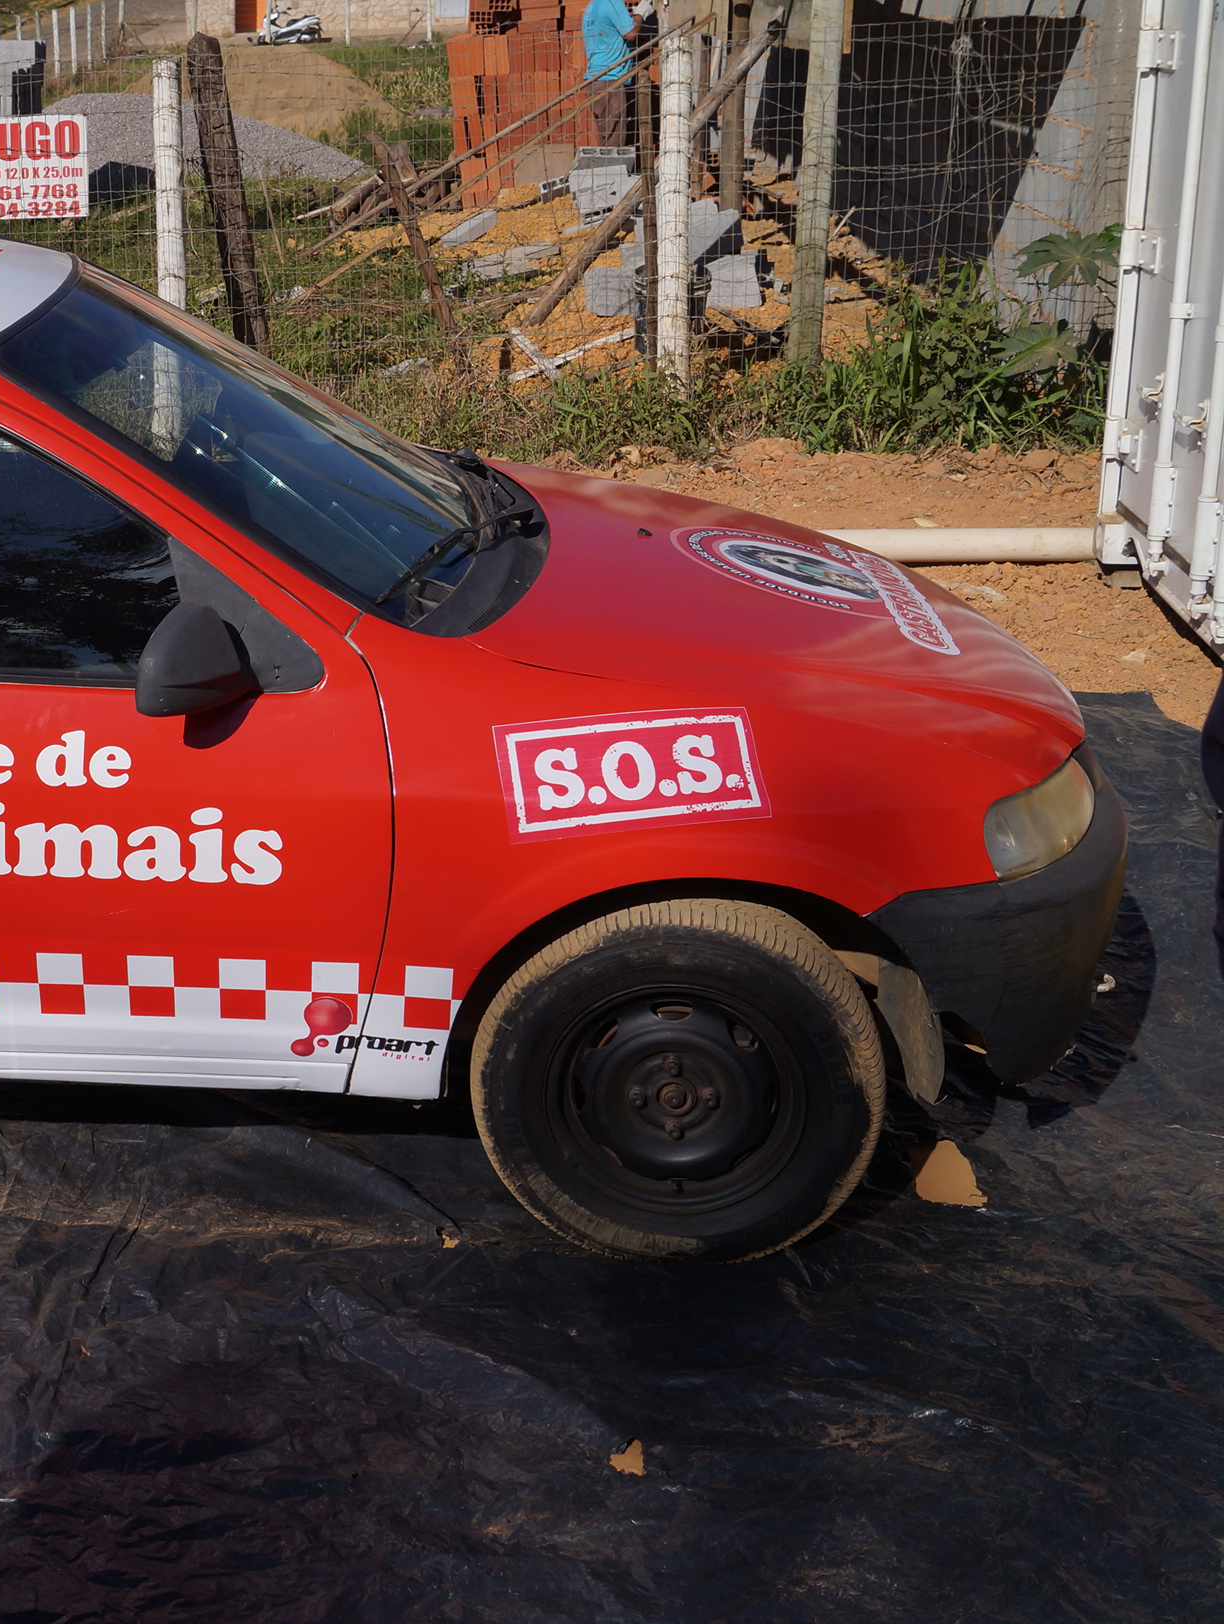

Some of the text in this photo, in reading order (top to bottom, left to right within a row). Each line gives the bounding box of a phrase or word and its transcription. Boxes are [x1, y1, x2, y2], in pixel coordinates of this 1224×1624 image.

[33, 167, 41, 179] X
[35, 730, 132, 788] de
[534, 734, 745, 811] S.O.S.
[335, 1035, 440, 1056] proart
